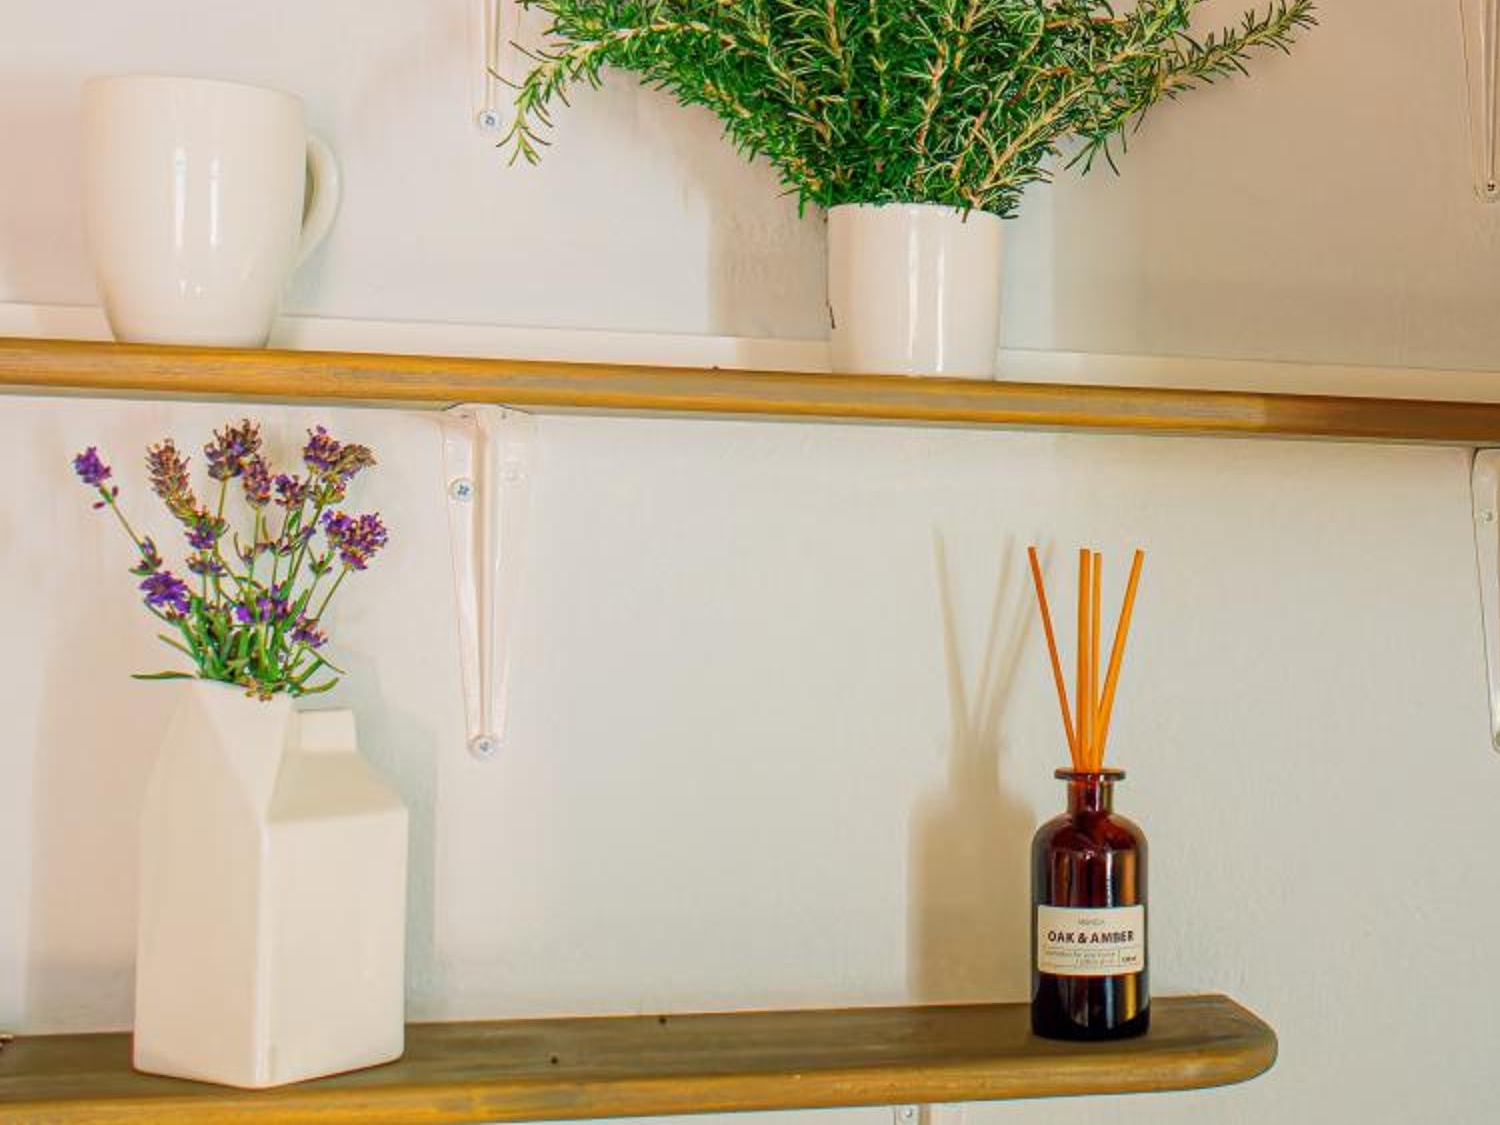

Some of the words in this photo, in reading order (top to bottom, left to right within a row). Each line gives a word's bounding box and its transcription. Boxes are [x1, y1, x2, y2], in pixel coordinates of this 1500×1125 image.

[1047, 930, 1075, 943] OAK
[1077, 931, 1088, 944] &
[1089, 929, 1135, 944] AMBER
